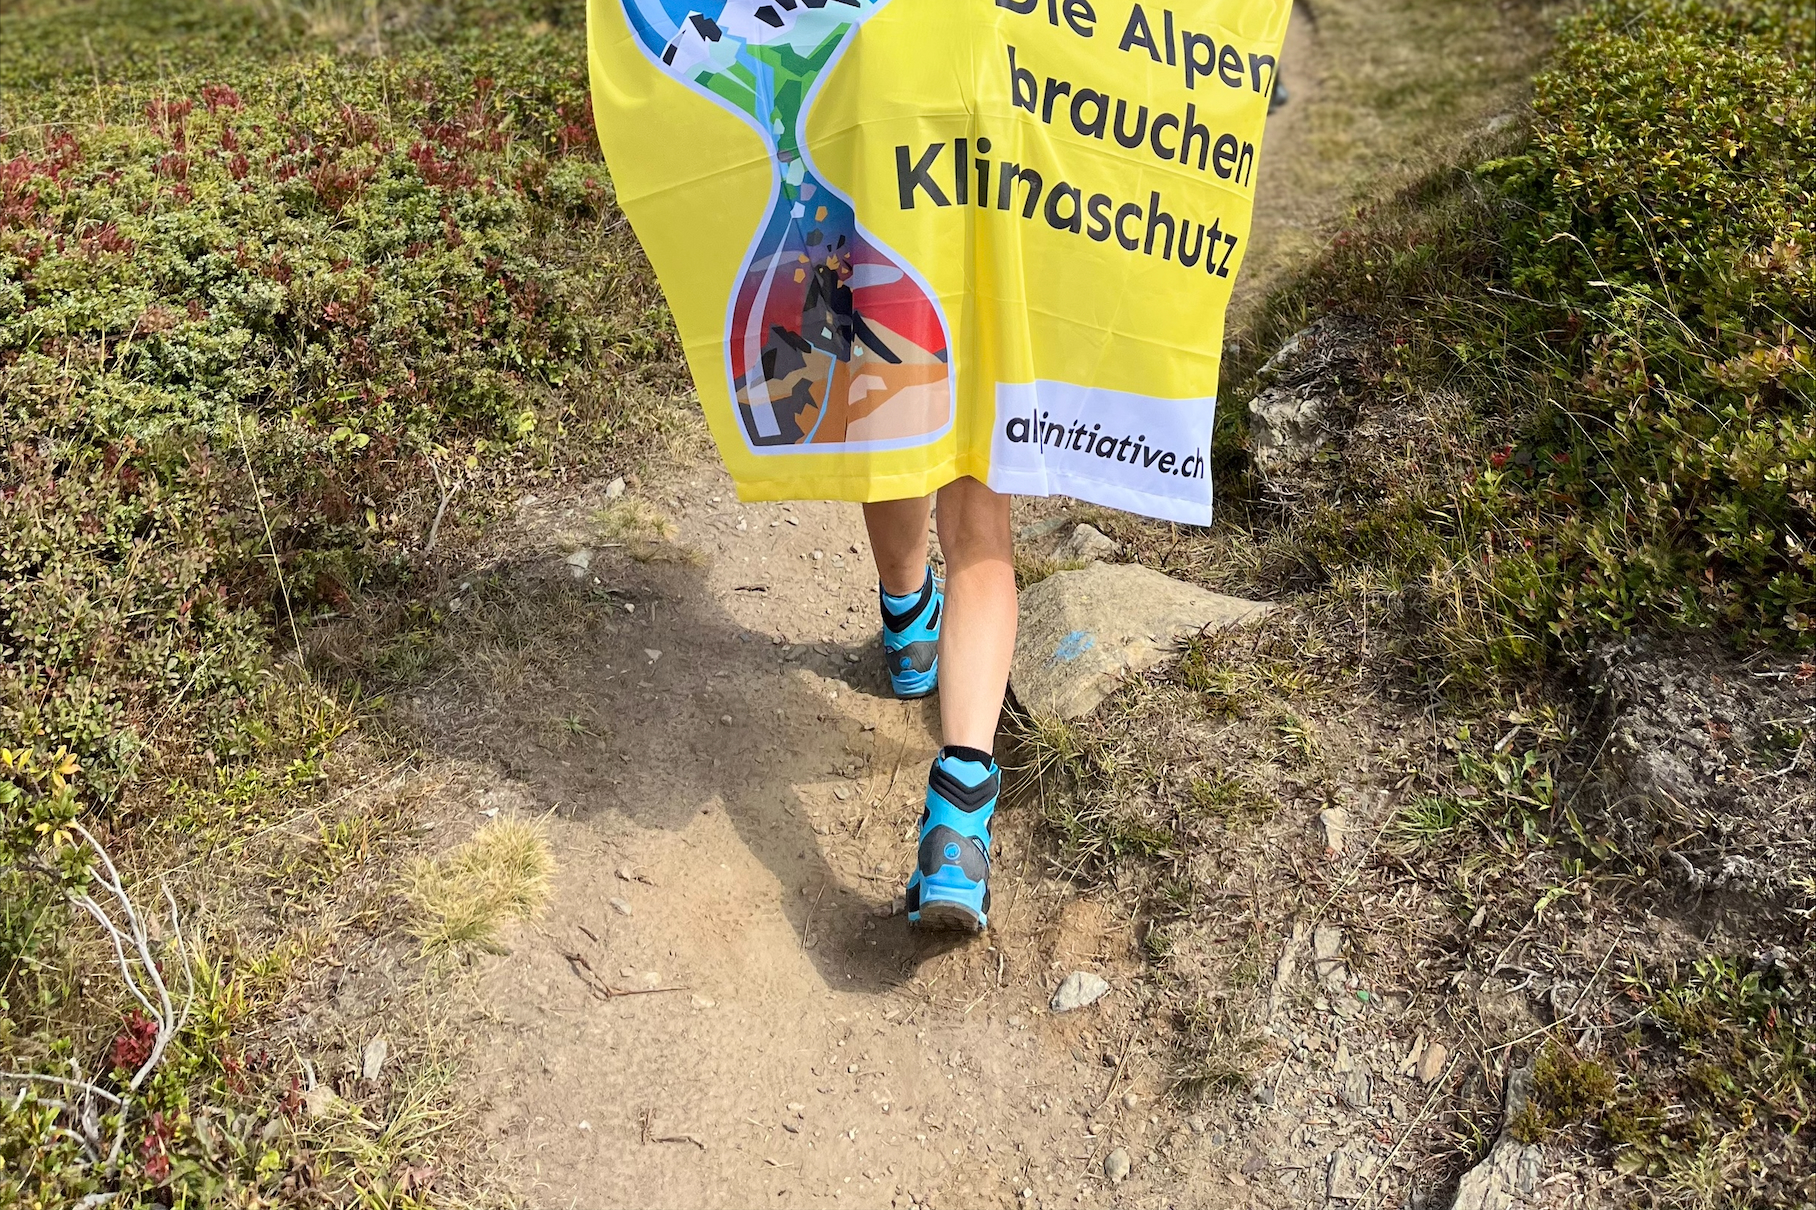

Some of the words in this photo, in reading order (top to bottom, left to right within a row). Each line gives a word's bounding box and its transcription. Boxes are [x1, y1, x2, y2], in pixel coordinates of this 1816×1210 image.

[1007, 44, 1254, 187] brauchen
[1119, 3, 1276, 97] Alpen
[895, 137, 1238, 278] Klimaschutz
